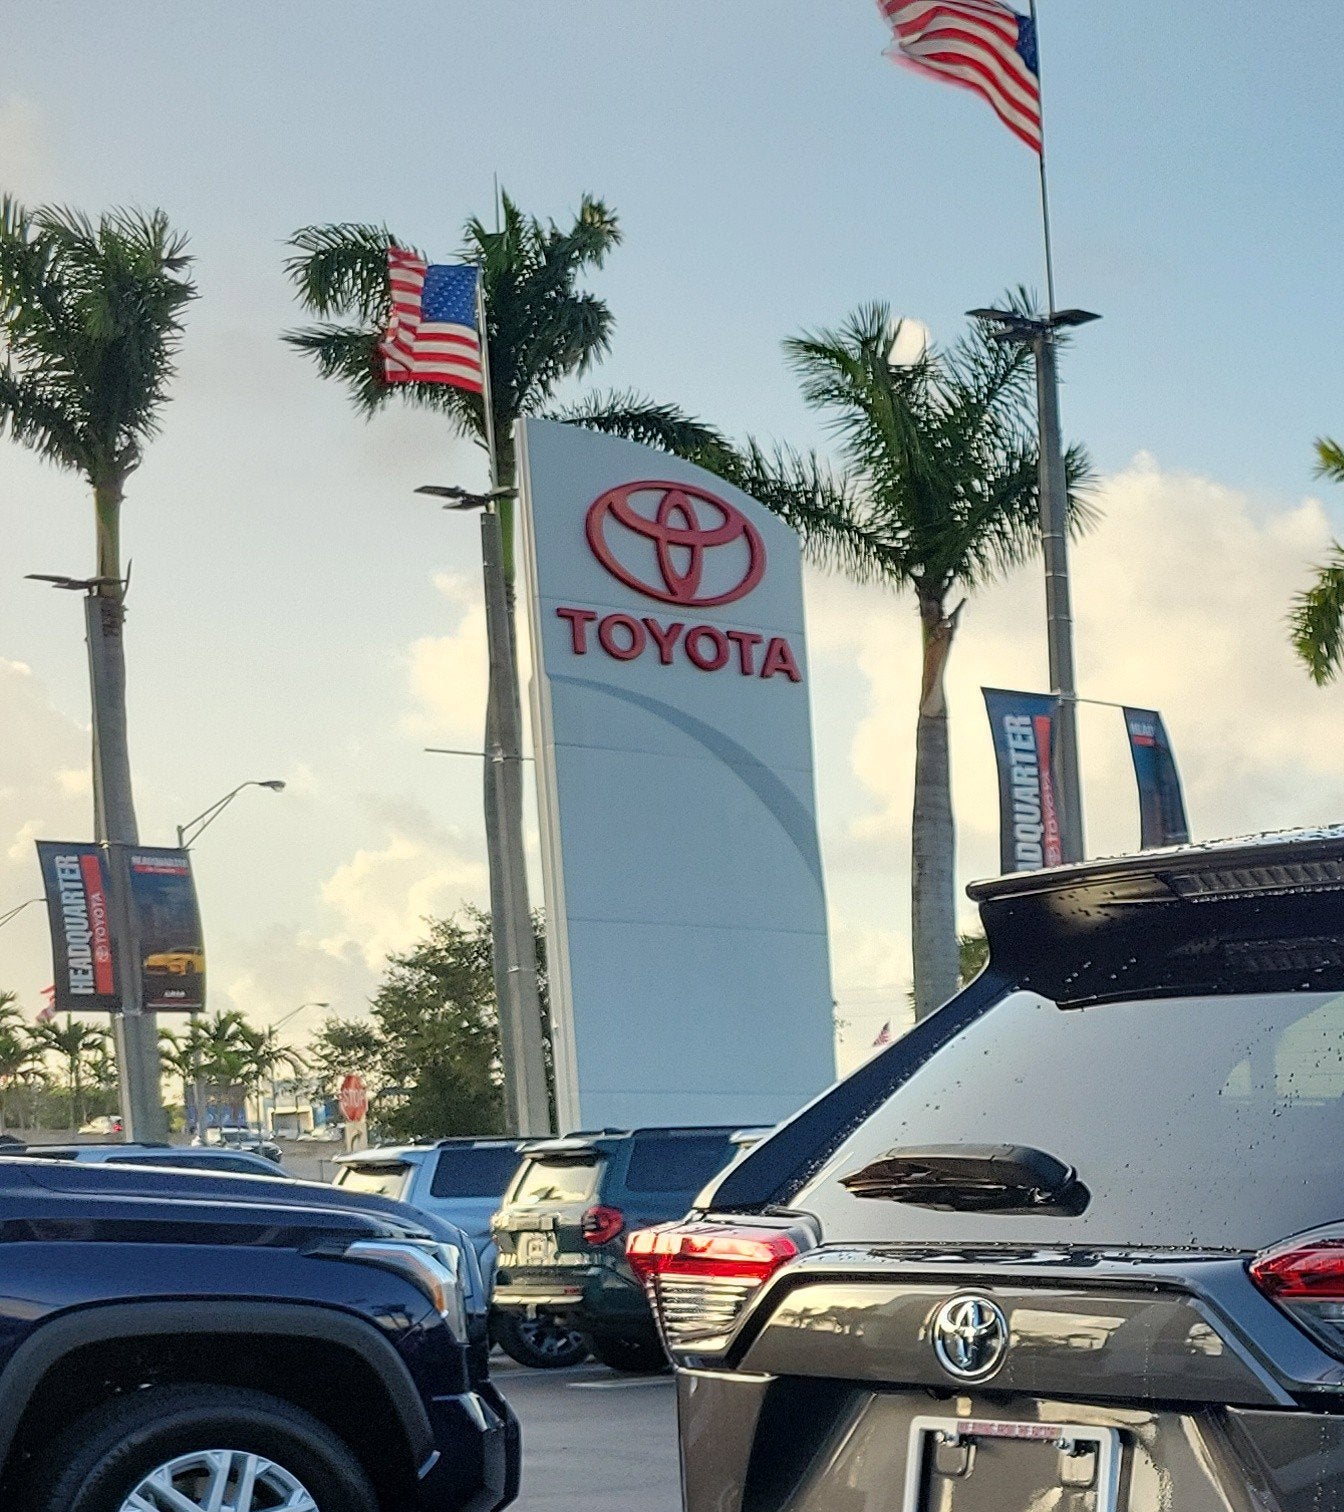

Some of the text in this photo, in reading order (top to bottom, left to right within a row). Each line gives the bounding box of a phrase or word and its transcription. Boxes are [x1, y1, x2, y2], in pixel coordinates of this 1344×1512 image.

[556, 607, 802, 683] TOYOTA
[54, 855, 95, 994] HEADQUARTER
[90, 892, 108, 944] TOYOTA
